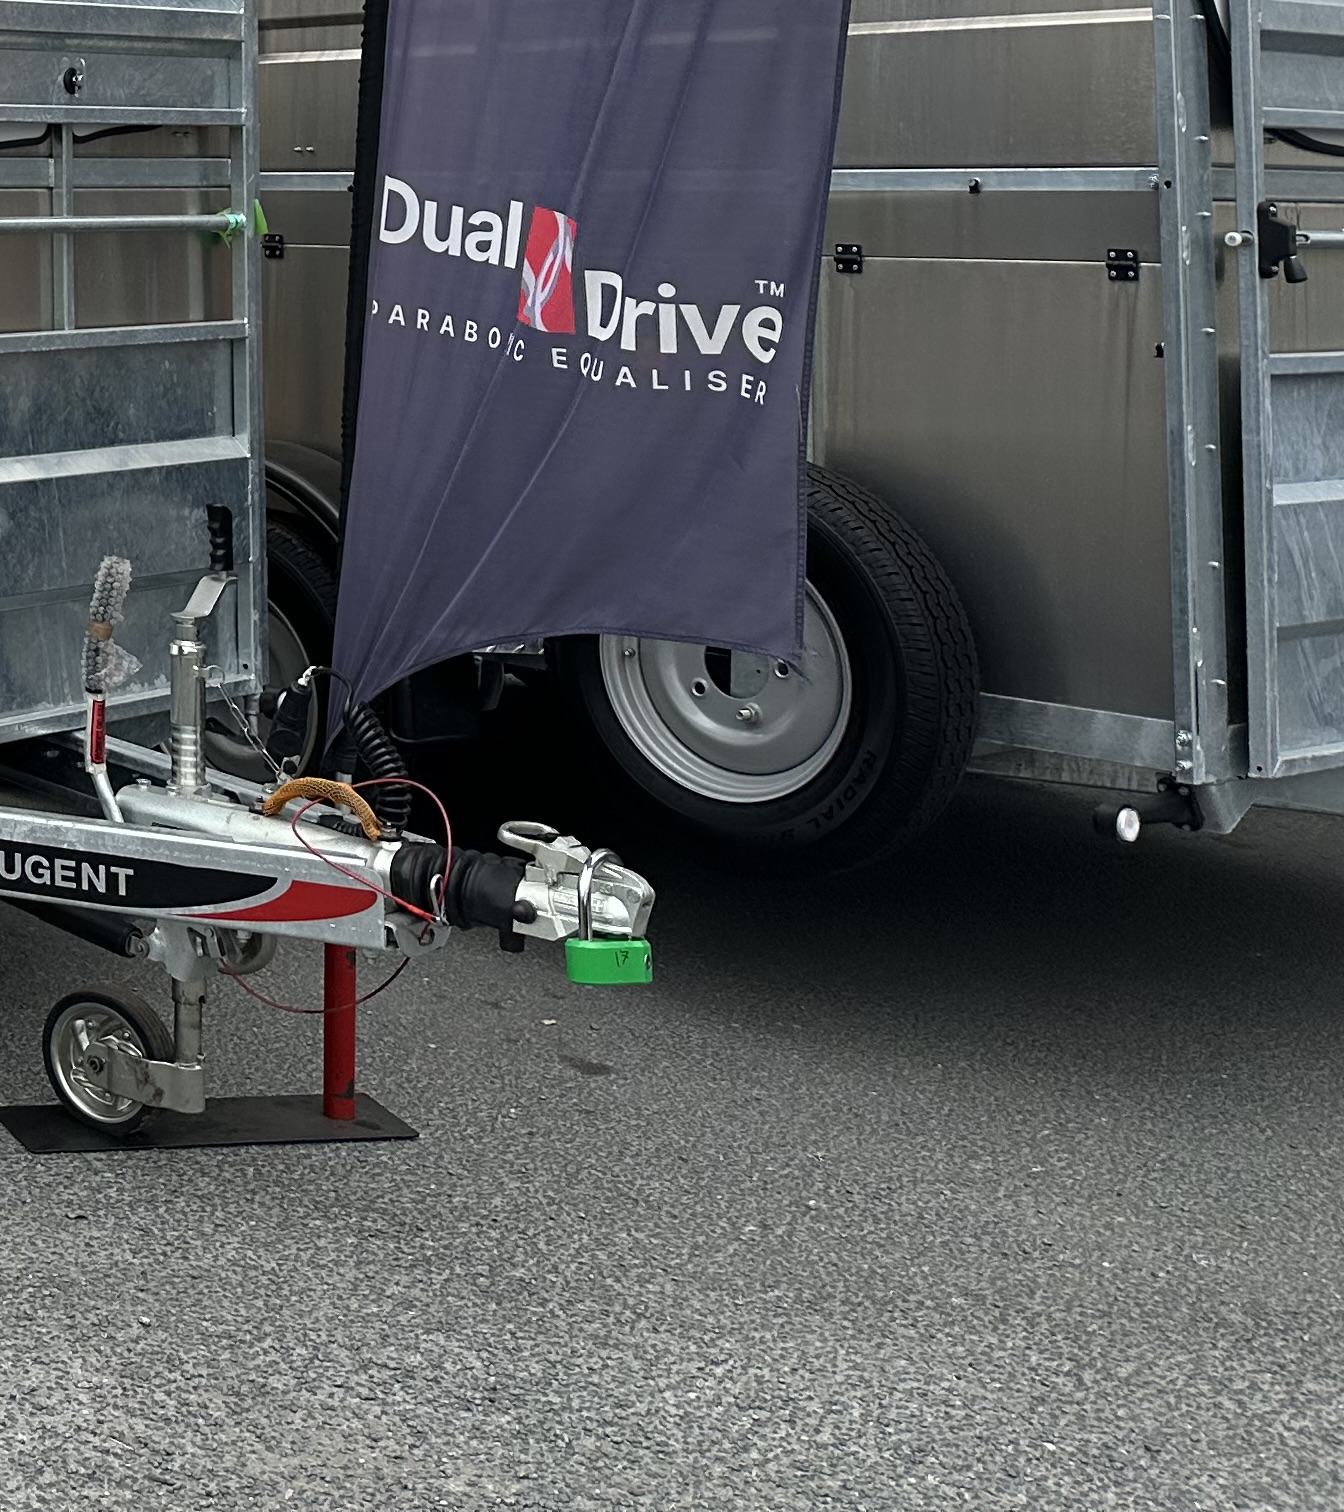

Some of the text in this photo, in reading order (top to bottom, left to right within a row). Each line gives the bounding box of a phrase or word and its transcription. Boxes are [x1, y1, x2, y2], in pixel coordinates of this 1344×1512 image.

[379, 175, 524, 269] Dual
[584, 270, 783, 363] Drive
[551, 347, 767, 405] EQUALISER
[807, 750, 877, 828] RADIAL
[615, 950, 629, 968] 17
